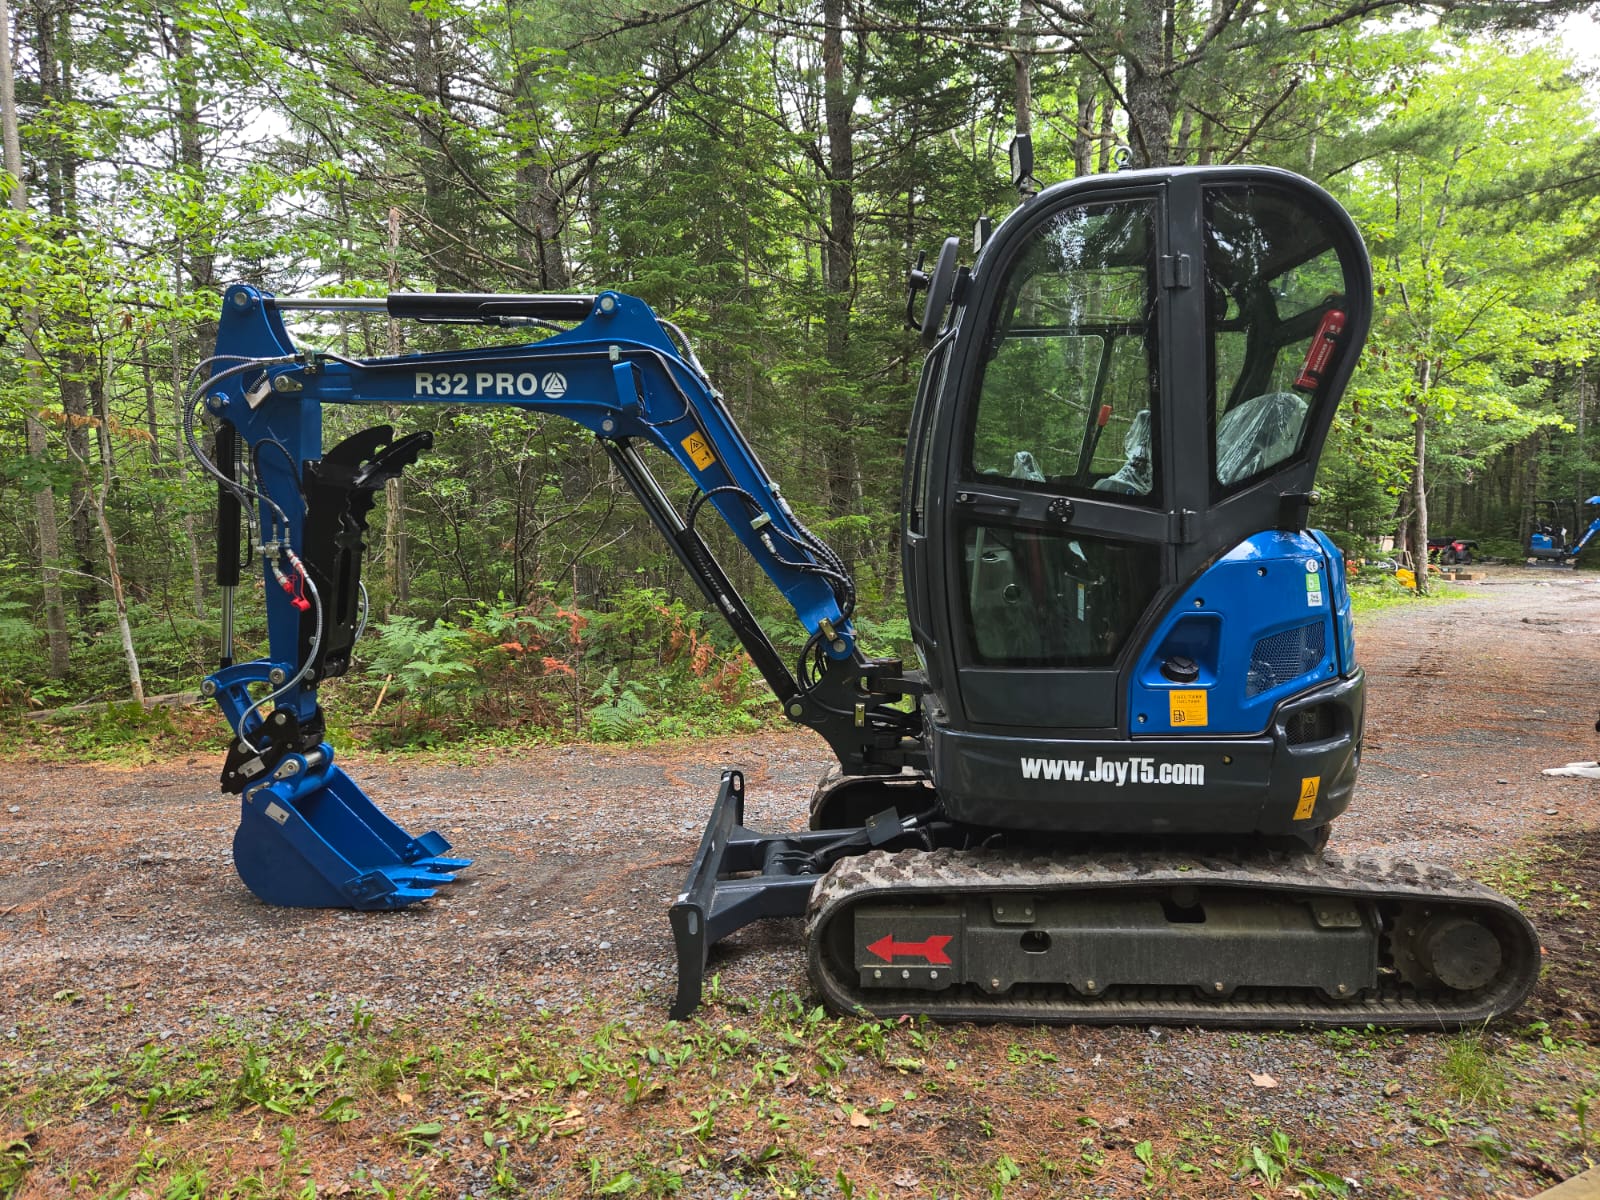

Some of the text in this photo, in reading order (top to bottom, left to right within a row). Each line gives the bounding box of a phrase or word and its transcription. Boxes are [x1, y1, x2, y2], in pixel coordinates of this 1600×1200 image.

[415, 372, 538, 396] R32 PRO
[1020, 756, 1205, 787] www.JoyT5.com
